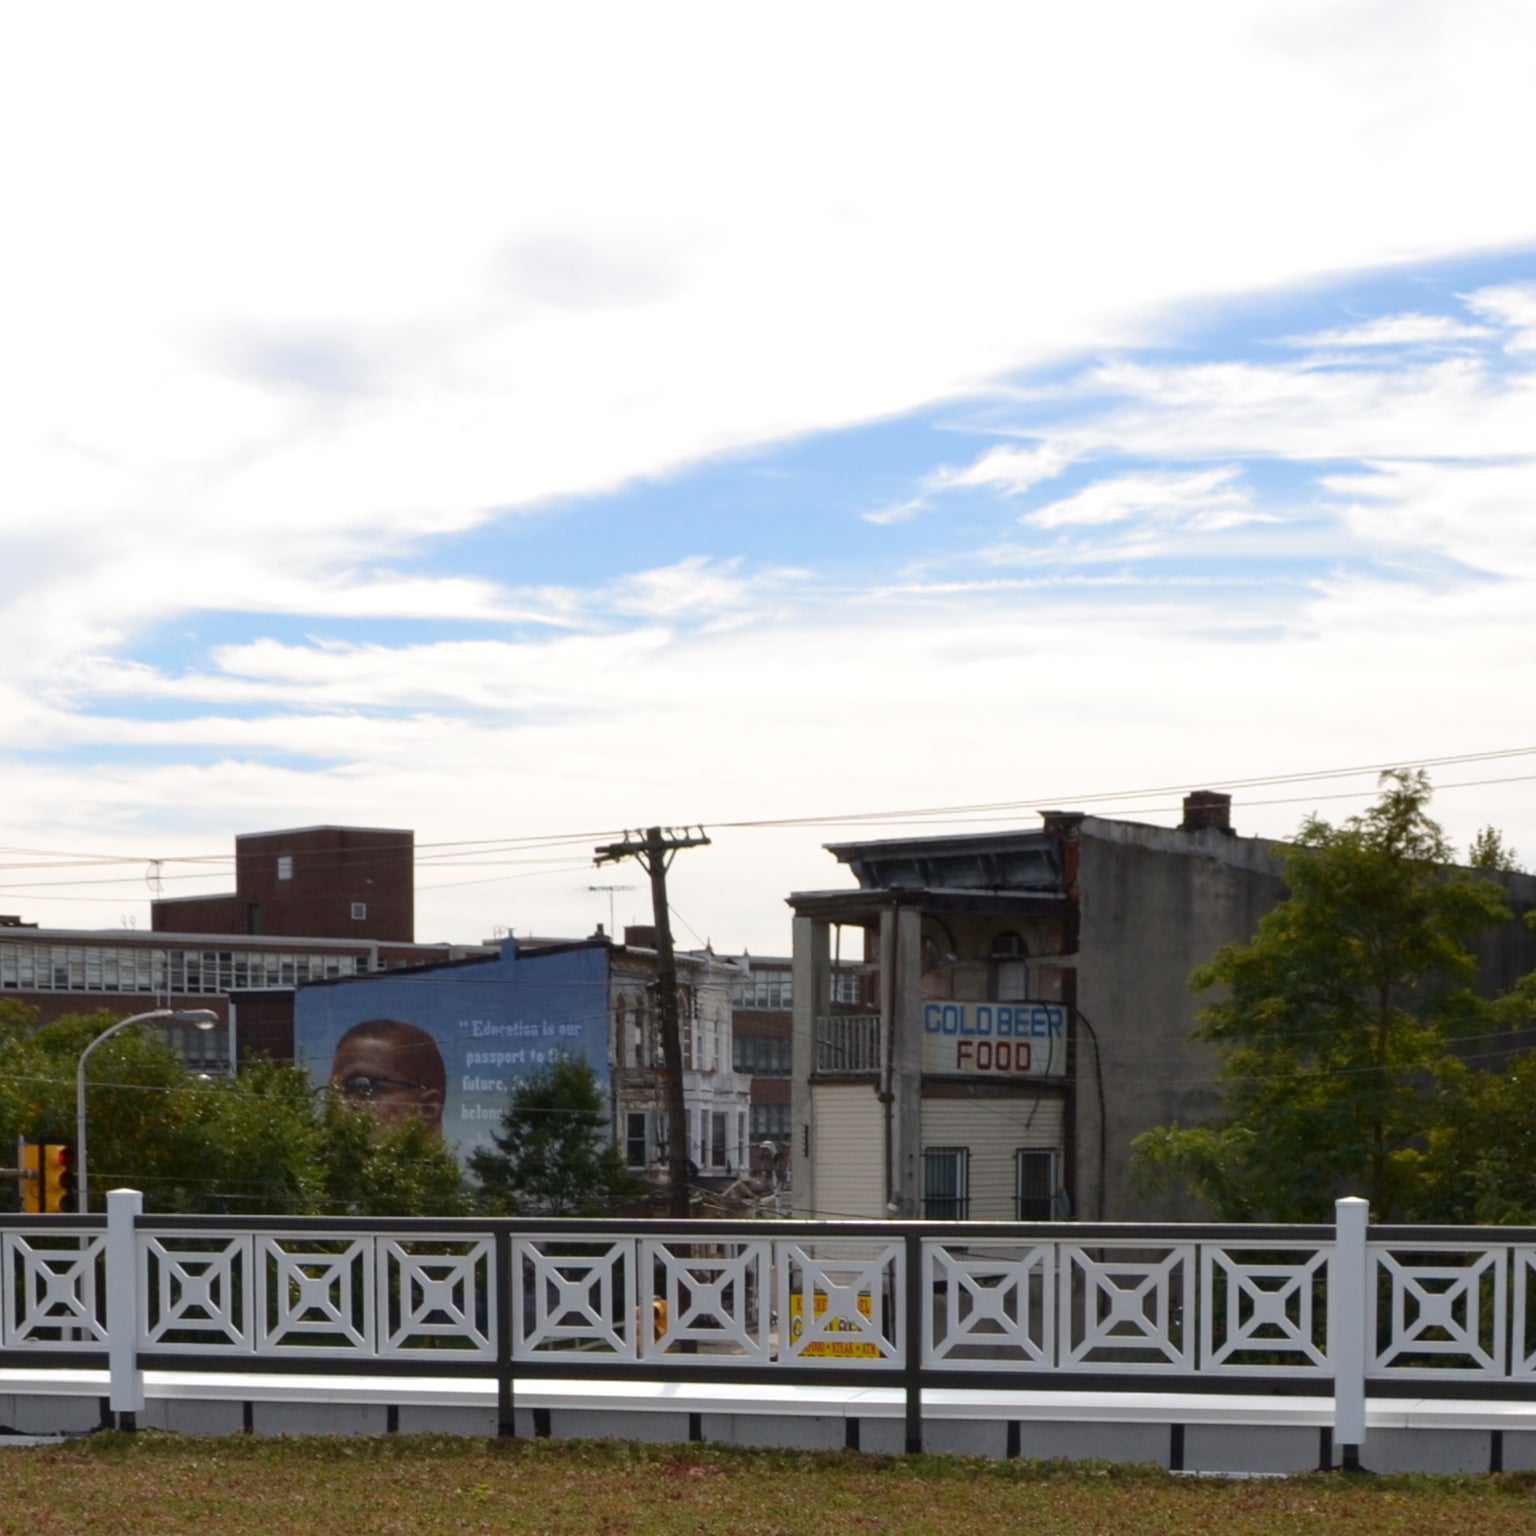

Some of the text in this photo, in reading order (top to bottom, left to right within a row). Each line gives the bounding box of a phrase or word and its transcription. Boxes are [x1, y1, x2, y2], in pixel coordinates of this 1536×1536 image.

[542, 1019, 555, 1036] is
[559, 1023, 582, 1036] our
[924, 1004, 1064, 1037] COLD BEER
[465, 1048, 525, 1068] passport
[957, 1040, 1032, 1071] FOOD
